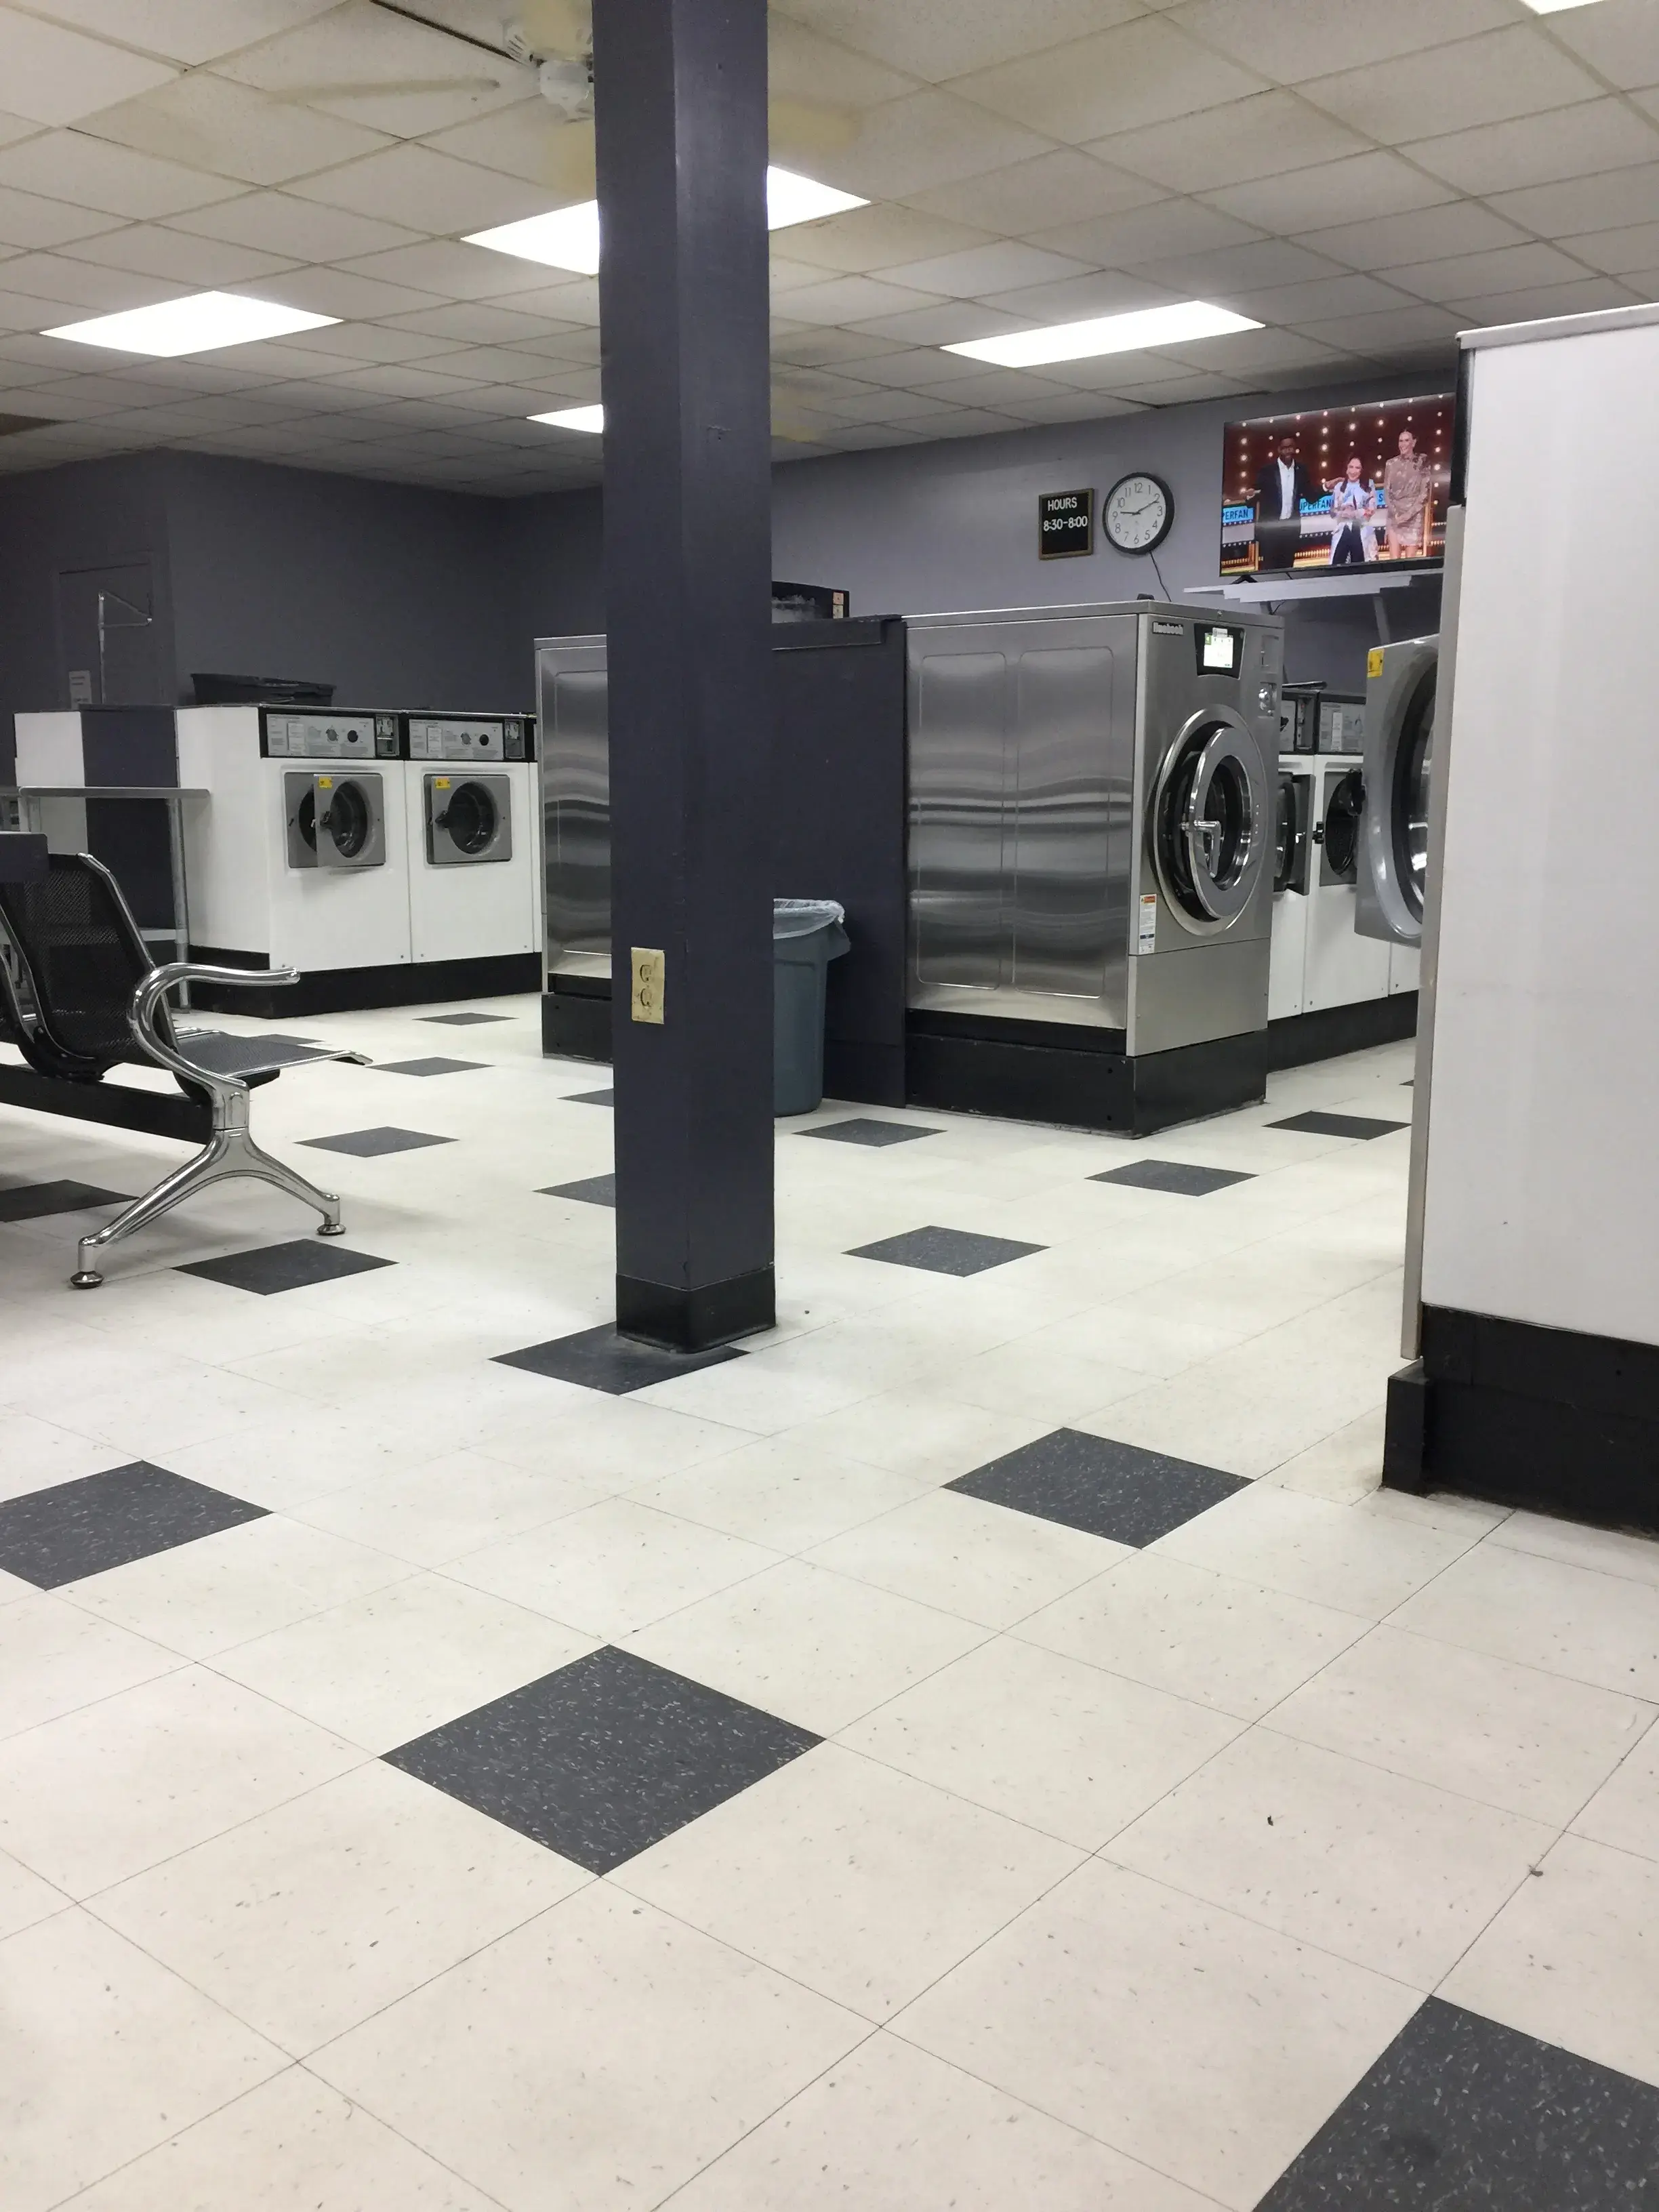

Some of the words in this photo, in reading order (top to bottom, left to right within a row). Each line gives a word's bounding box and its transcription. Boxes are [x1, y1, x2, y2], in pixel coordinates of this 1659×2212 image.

[1124, 487, 1131, 498] 11
[1134, 482, 1143, 493] 12
[1148, 485, 1151, 495] 1
[1116, 497, 1125, 508] 10
[1154, 493, 1160, 503] 2
[1047, 497, 1078, 511] HOURS
[1112, 511, 1118, 521] 9
[1156, 506, 1163, 516] 3
[1043, 515, 1088, 532] 8:30-8:00
[1115, 523, 1121, 533] 8
[1151, 520, 1158, 529] 4
[1124, 531, 1129, 542] 7
[1133, 534, 1139, 544] 6
[1144, 529, 1151, 541] 5
